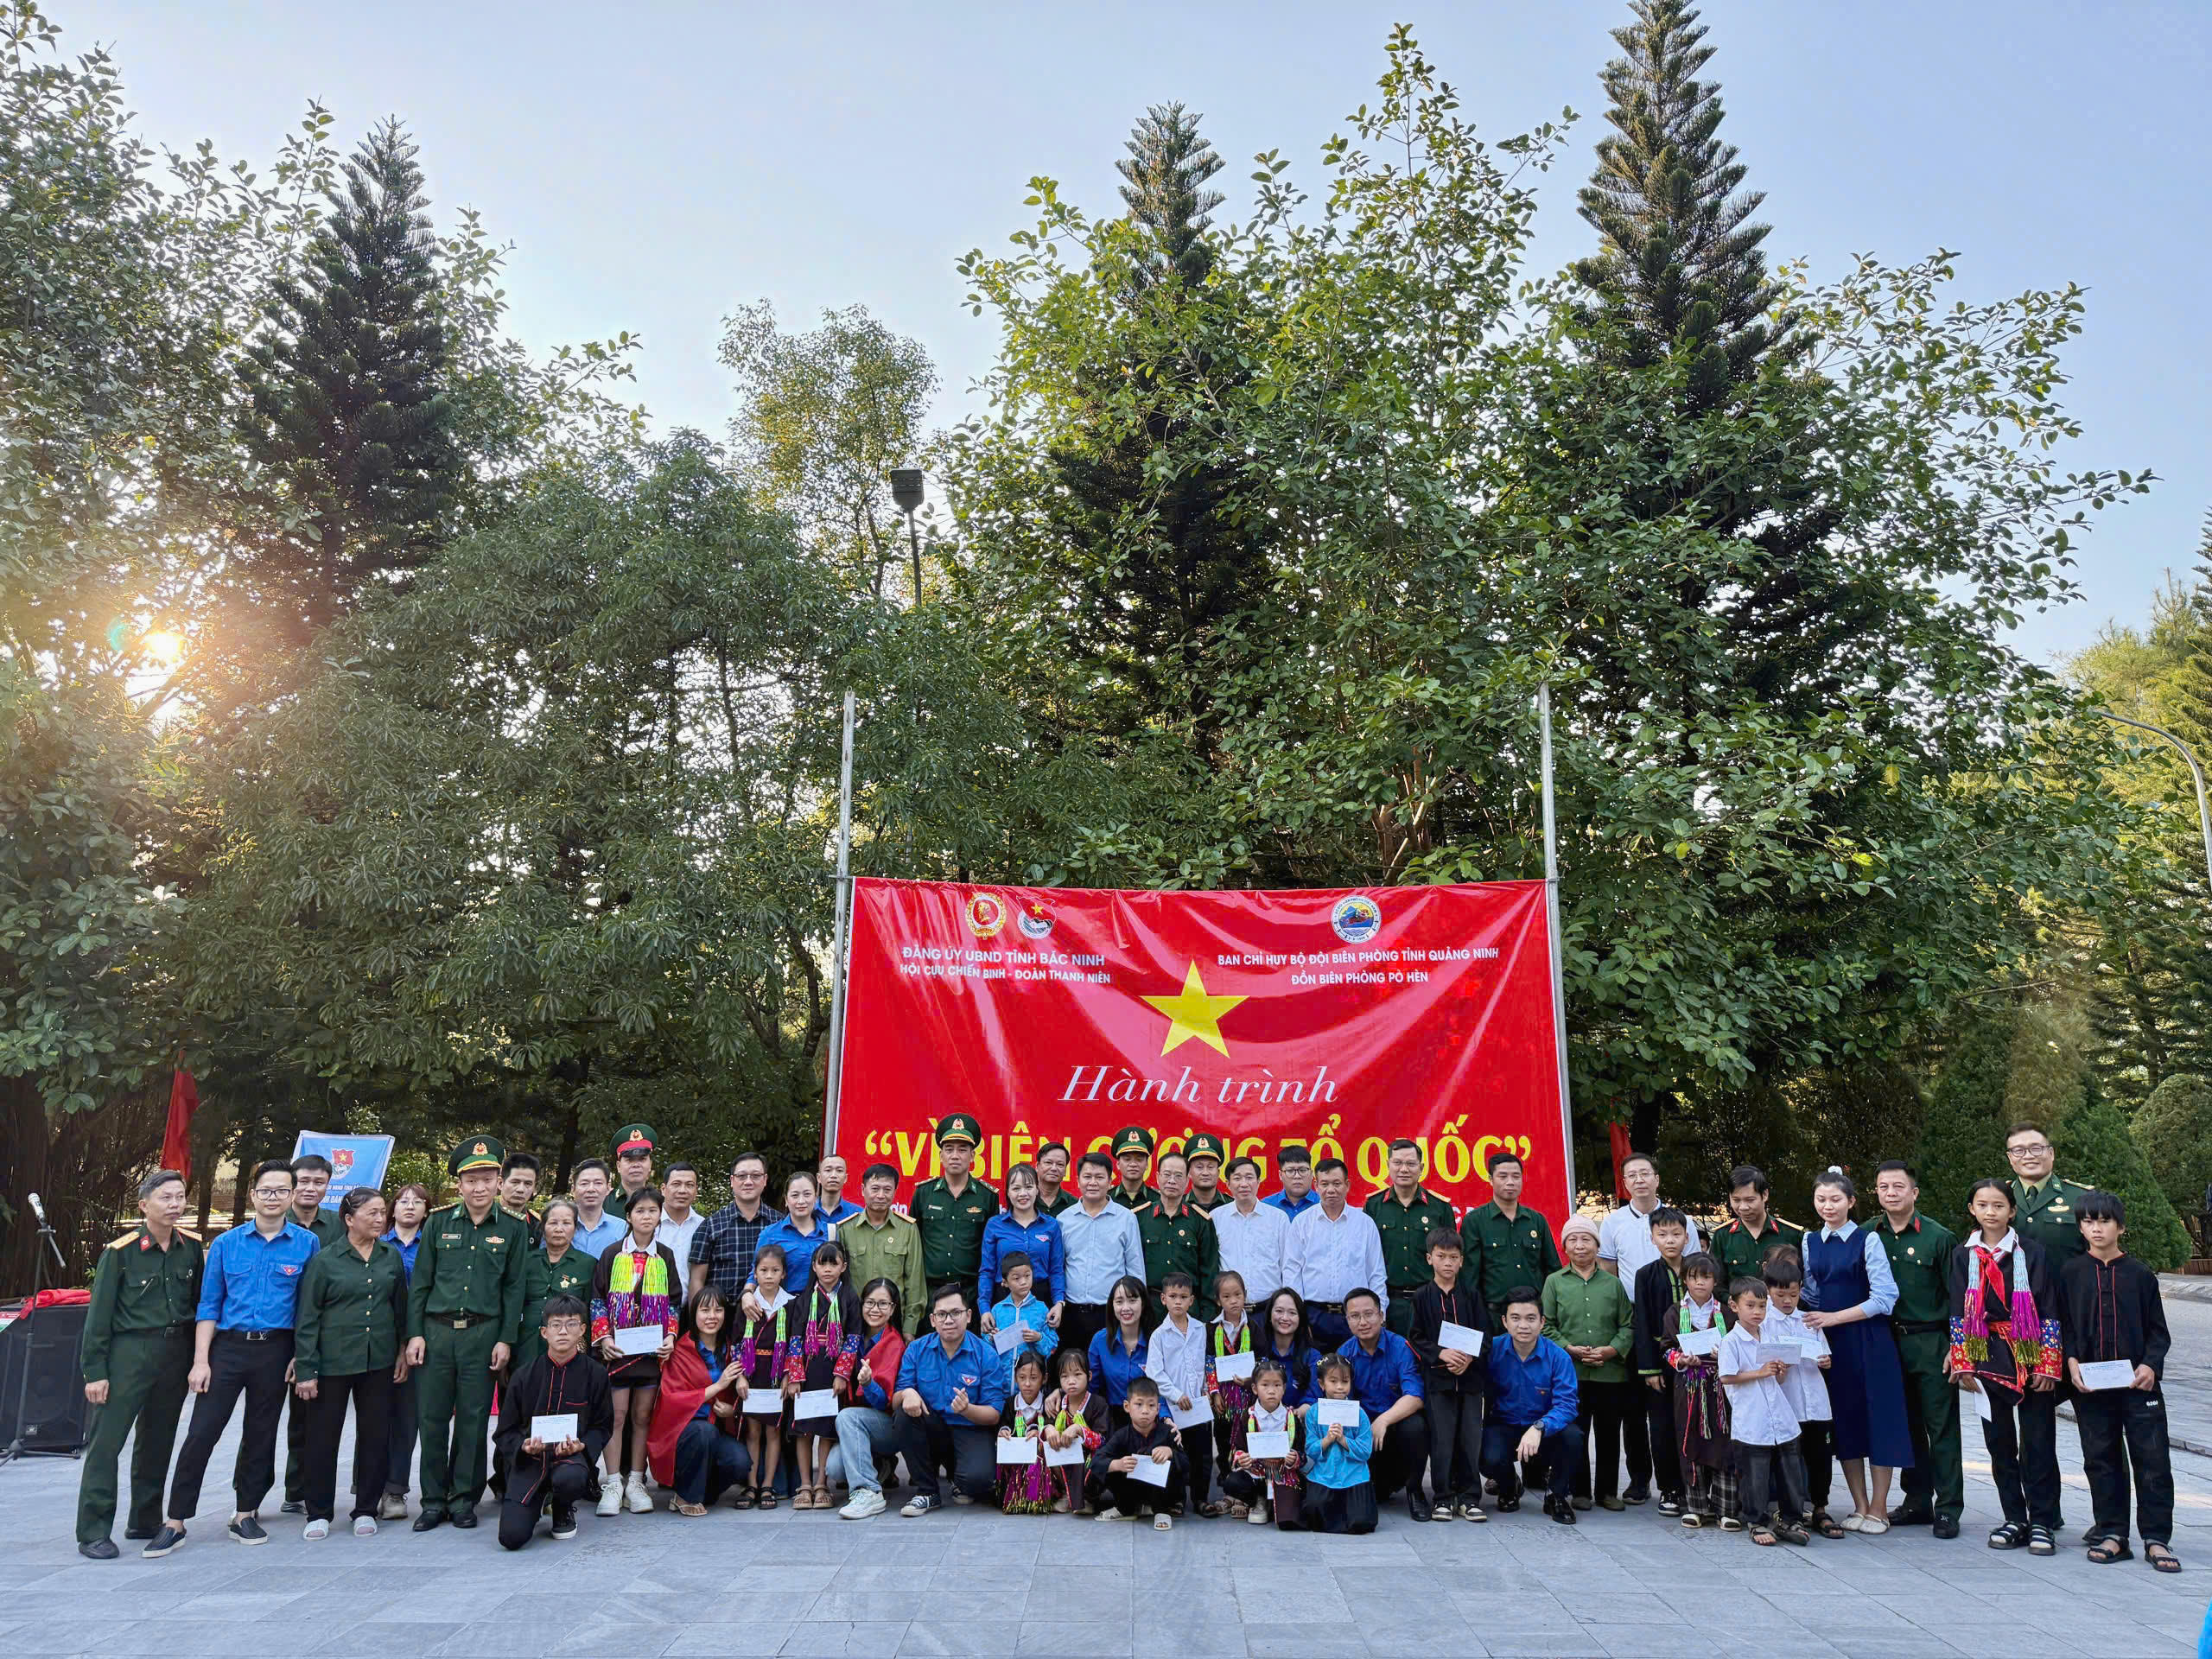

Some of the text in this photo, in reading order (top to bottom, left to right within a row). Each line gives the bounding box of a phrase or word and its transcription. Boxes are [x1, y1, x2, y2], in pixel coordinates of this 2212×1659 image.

[902, 944, 942, 960] ĐẢNG
[945, 946, 963, 960] ỦY
[966, 950, 1002, 963] UBND
[1005, 949, 1036, 964] TỈNH
[1071, 954, 1105, 966] NINH
[1217, 946, 1499, 968] BAN CHỈ HUY BỘ ĐỘI BIÊN PHÒNG TỈNH QUẢNG NINH
[899, 963, 920, 976] HỘI
[925, 964, 944, 978] CỰU
[947, 963, 980, 978] CHIẾN
[982, 969, 1006, 979] BINH
[1014, 967, 1046, 980] ĐOÀN
[1049, 969, 1084, 982] THANH
[1087, 970, 1111, 983] NIÊN
[1291, 969, 1316, 985] ĐỒN
[1319, 971, 1343, 984] BIÊN
[1345, 969, 1385, 983] PHÒNG
[1407, 969, 1428, 982] HÈN
[1058, 1065, 1338, 1103] Hành trình
[1279, 1114, 1344, 1180] Ổ
